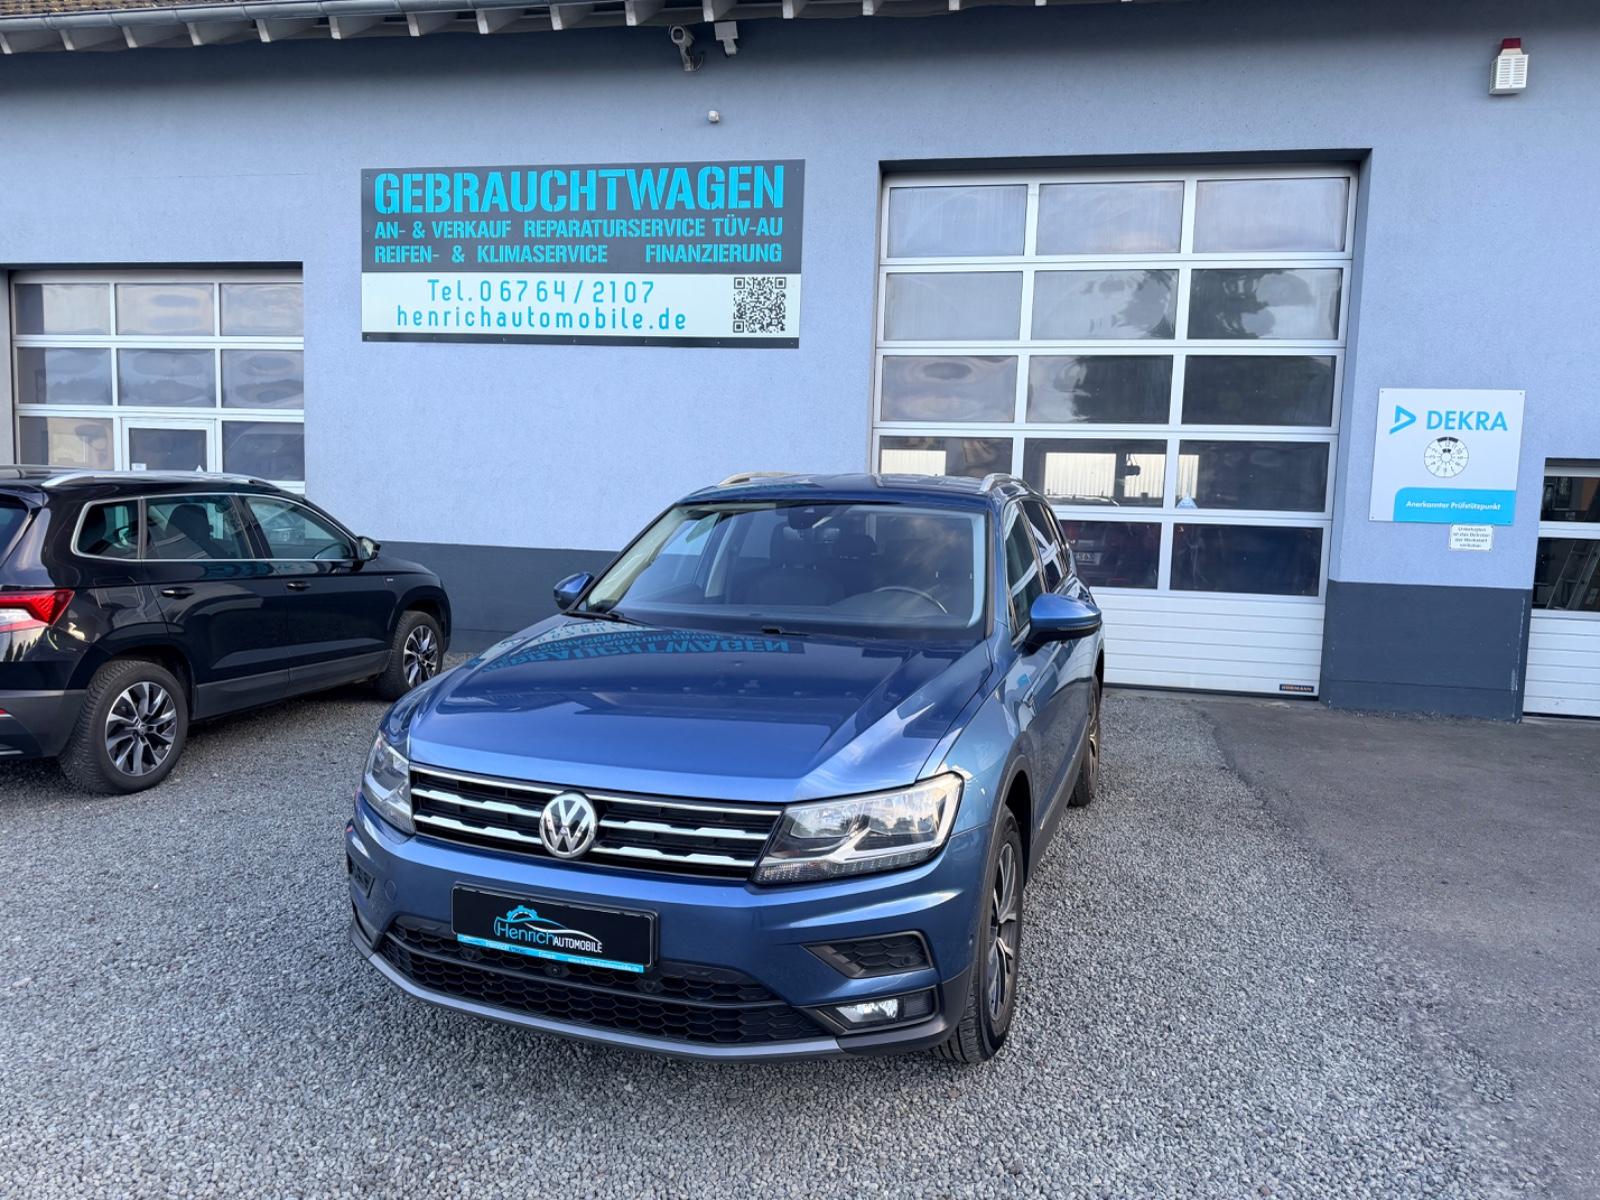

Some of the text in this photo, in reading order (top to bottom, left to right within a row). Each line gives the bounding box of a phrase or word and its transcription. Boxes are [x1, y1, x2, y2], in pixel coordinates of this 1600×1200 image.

[374, 165, 785, 215] GEBRAUCHTWAGEN
[374, 213, 783, 239] AN- & VERKAUF REPARATURSERVICE TÜV-AU
[374, 243, 783, 263] REIFEN- & KLIMASERVICE FINANZIERUNG
[397, 305, 686, 330] henrichautomobile.de
[1426, 409, 1508, 431] DEKRA
[1406, 500, 1501, 511] Anerkannter Prüfstützpunkt
[542, 793, 596, 857] VW
[497, 922, 554, 946] Henrich
[553, 935, 603, 953] AUTOMOBILE
